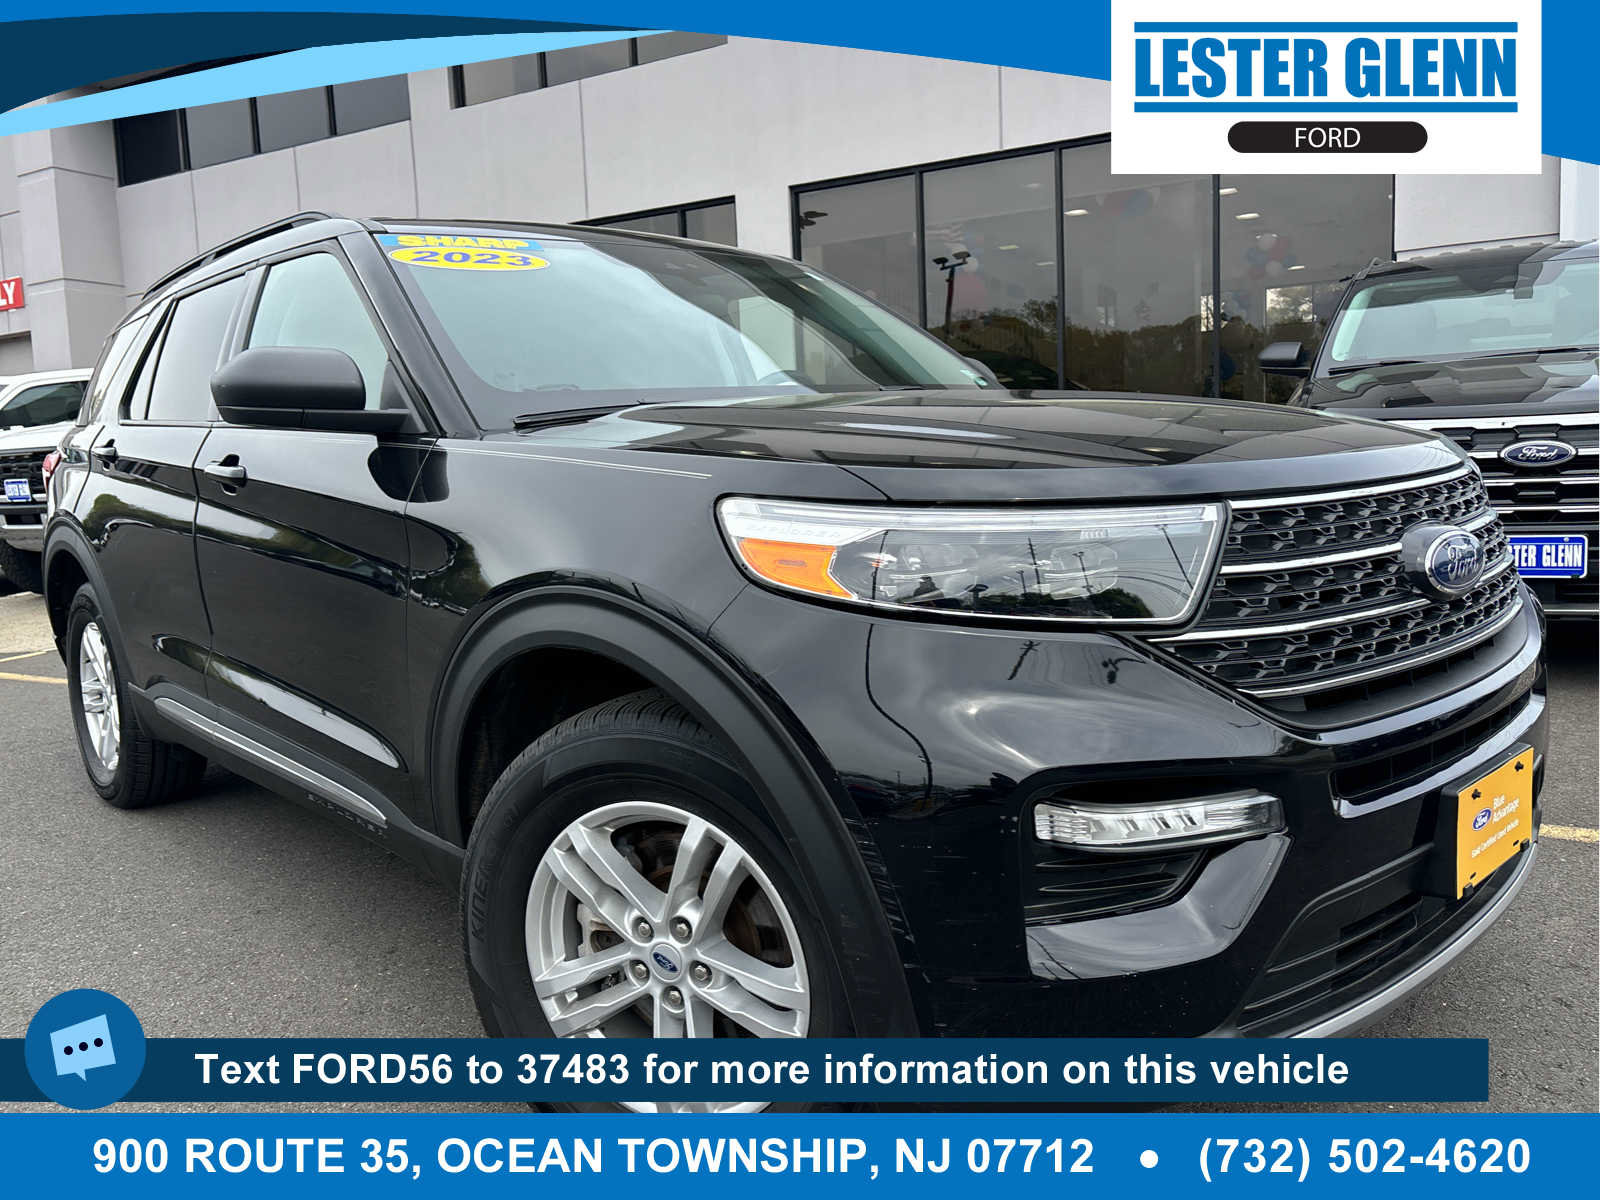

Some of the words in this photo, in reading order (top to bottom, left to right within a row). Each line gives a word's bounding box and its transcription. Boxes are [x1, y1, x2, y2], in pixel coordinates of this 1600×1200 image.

[397, 235, 529, 249] SHARP
[412, 251, 532, 266] 2023
[1518, 446, 1559, 461] Ford
[1448, 544, 1479, 580] Ford
[1542, 544, 1582, 567] GLENN
[1493, 794, 1505, 808] Blue
